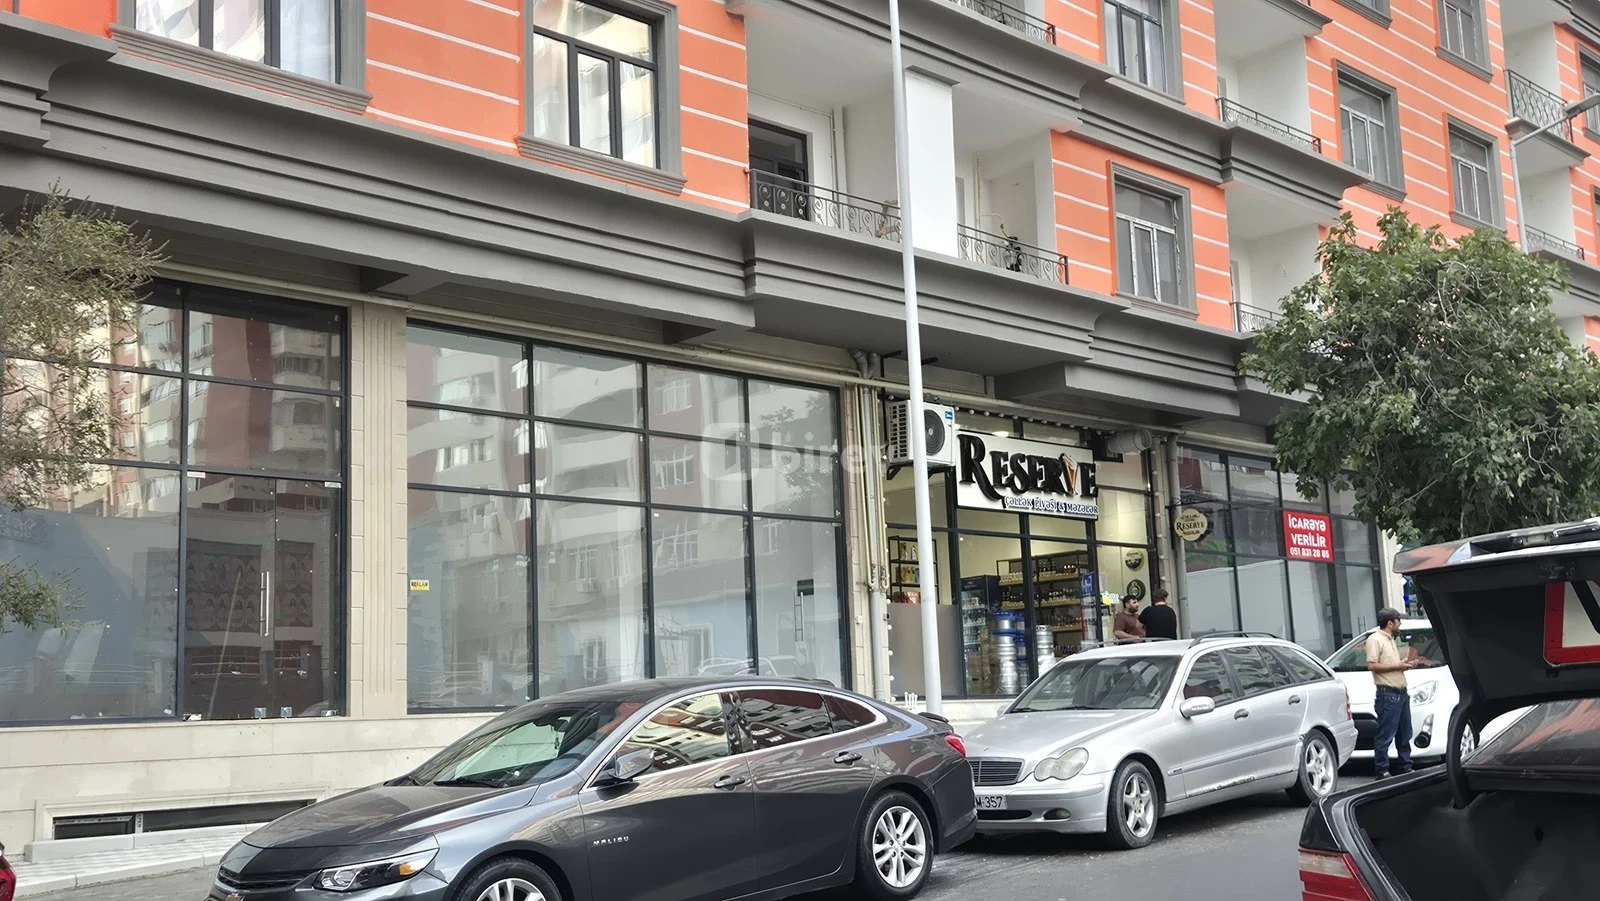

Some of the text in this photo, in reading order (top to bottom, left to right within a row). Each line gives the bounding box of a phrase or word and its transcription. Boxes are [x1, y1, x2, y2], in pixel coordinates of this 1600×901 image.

[957, 434, 1098, 499] RESERVE
[1288, 514, 1326, 532] İCARƏYƏ
[1291, 532, 1327, 548] VERİLİR
[1290, 547, 1300, 556] 051
[593, 836, 629, 845] MALIBU
